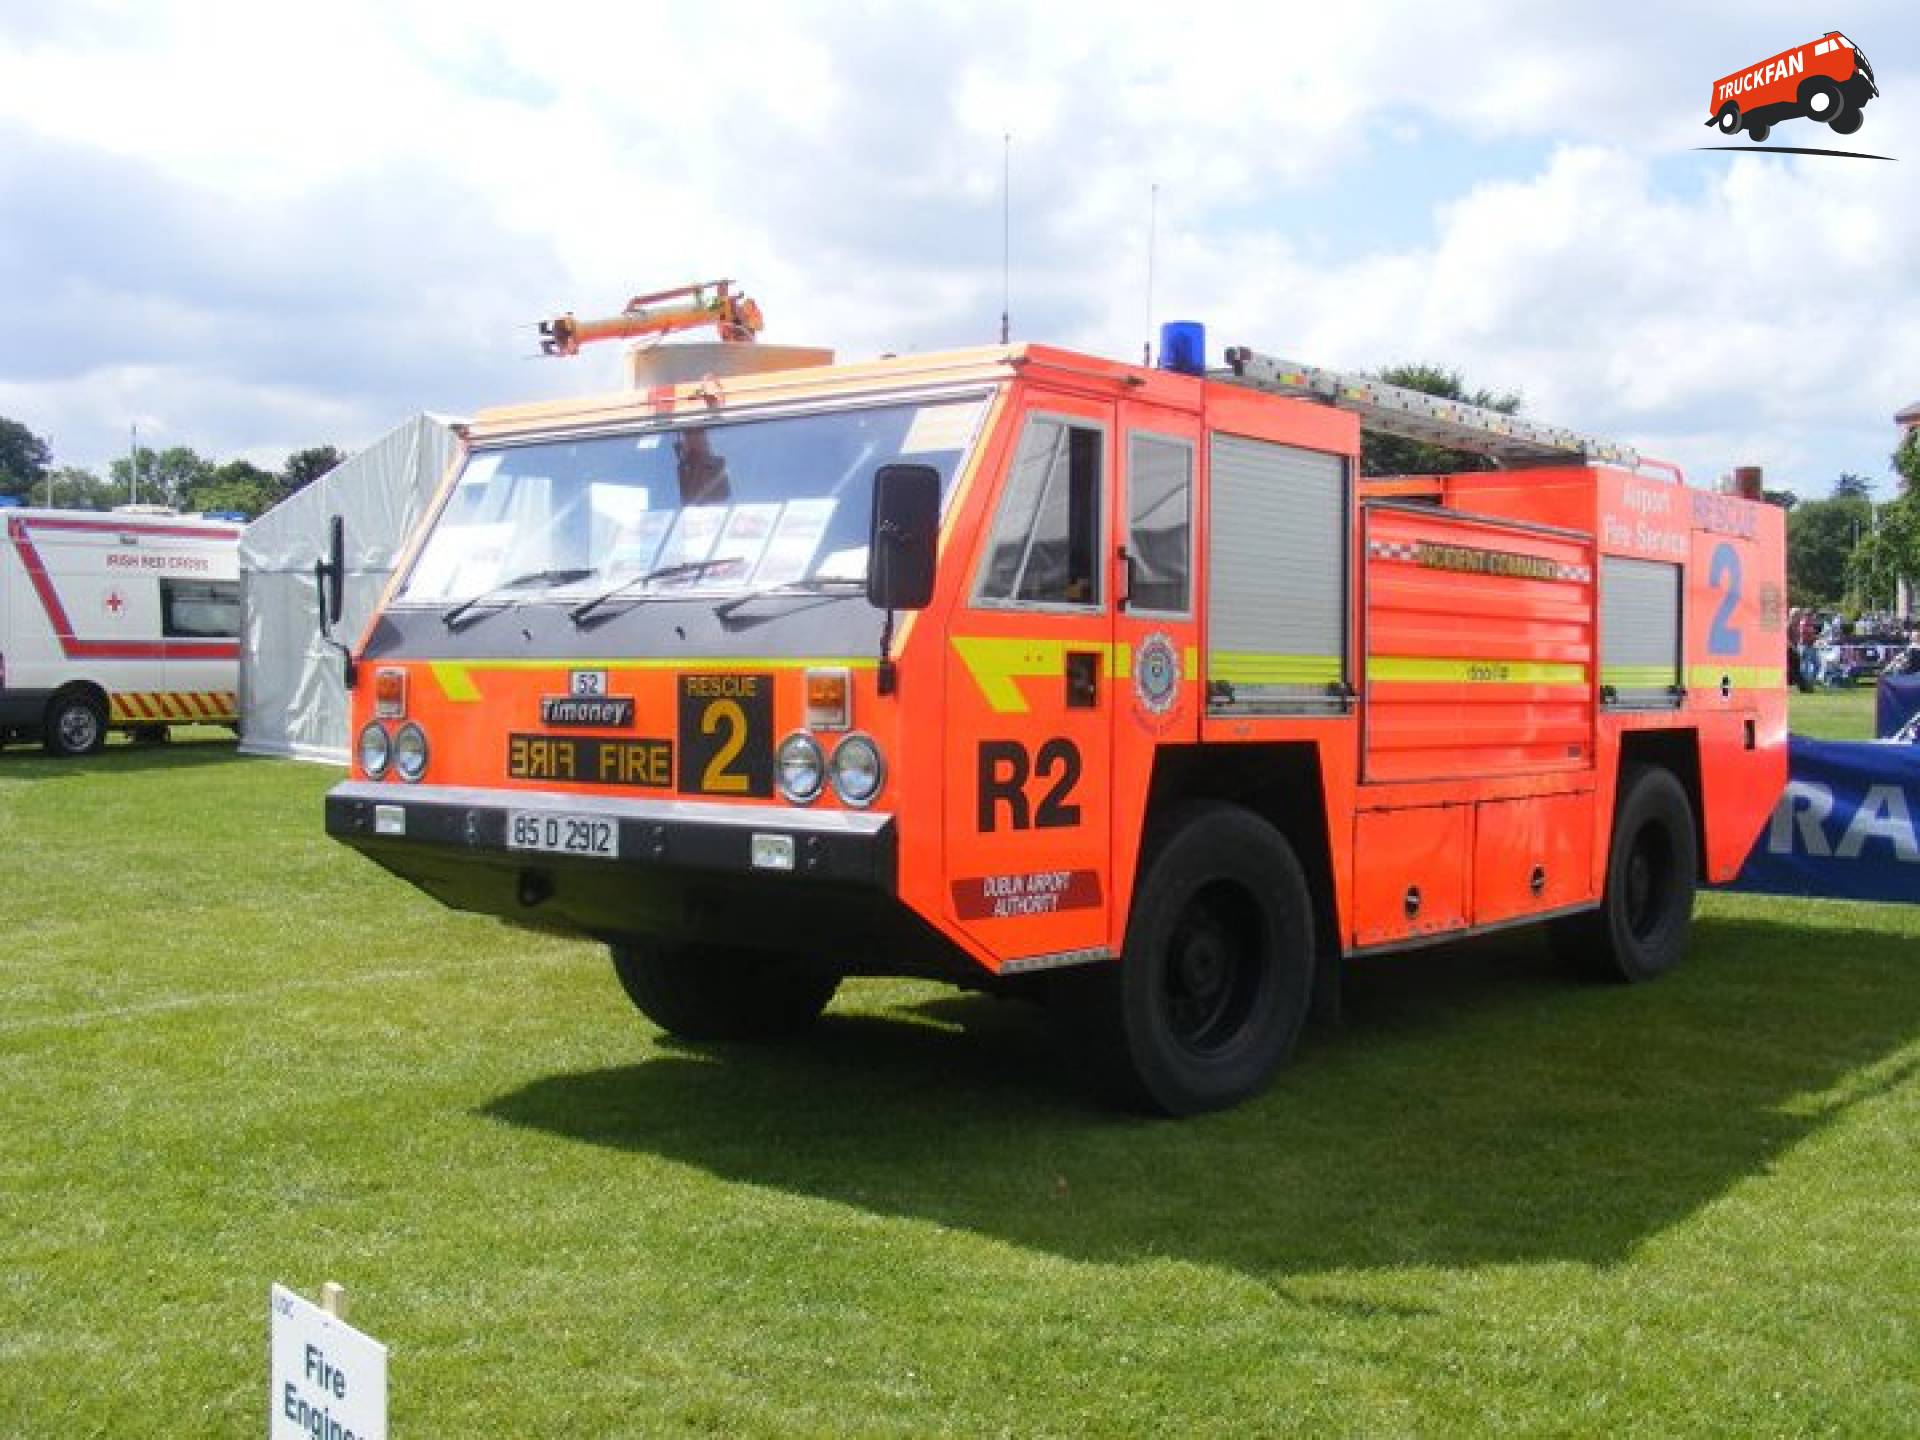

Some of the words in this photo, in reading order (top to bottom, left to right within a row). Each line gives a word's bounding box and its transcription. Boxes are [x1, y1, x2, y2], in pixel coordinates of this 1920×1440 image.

[106, 554, 139, 568] IRISH
[141, 556, 165, 568] RED
[1708, 544, 1742, 656] 2
[577, 673, 598, 694] 52
[687, 676, 758, 697] RESCUE
[542, 700, 626, 725] Timoney
[702, 699, 750, 791] 2
[599, 744, 670, 783] FIRE
[978, 738, 1081, 832] R2
[514, 818, 540, 846] 85
[547, 820, 558, 846] D
[565, 819, 611, 852] 2912
[306, 1344, 345, 1398] Fire
